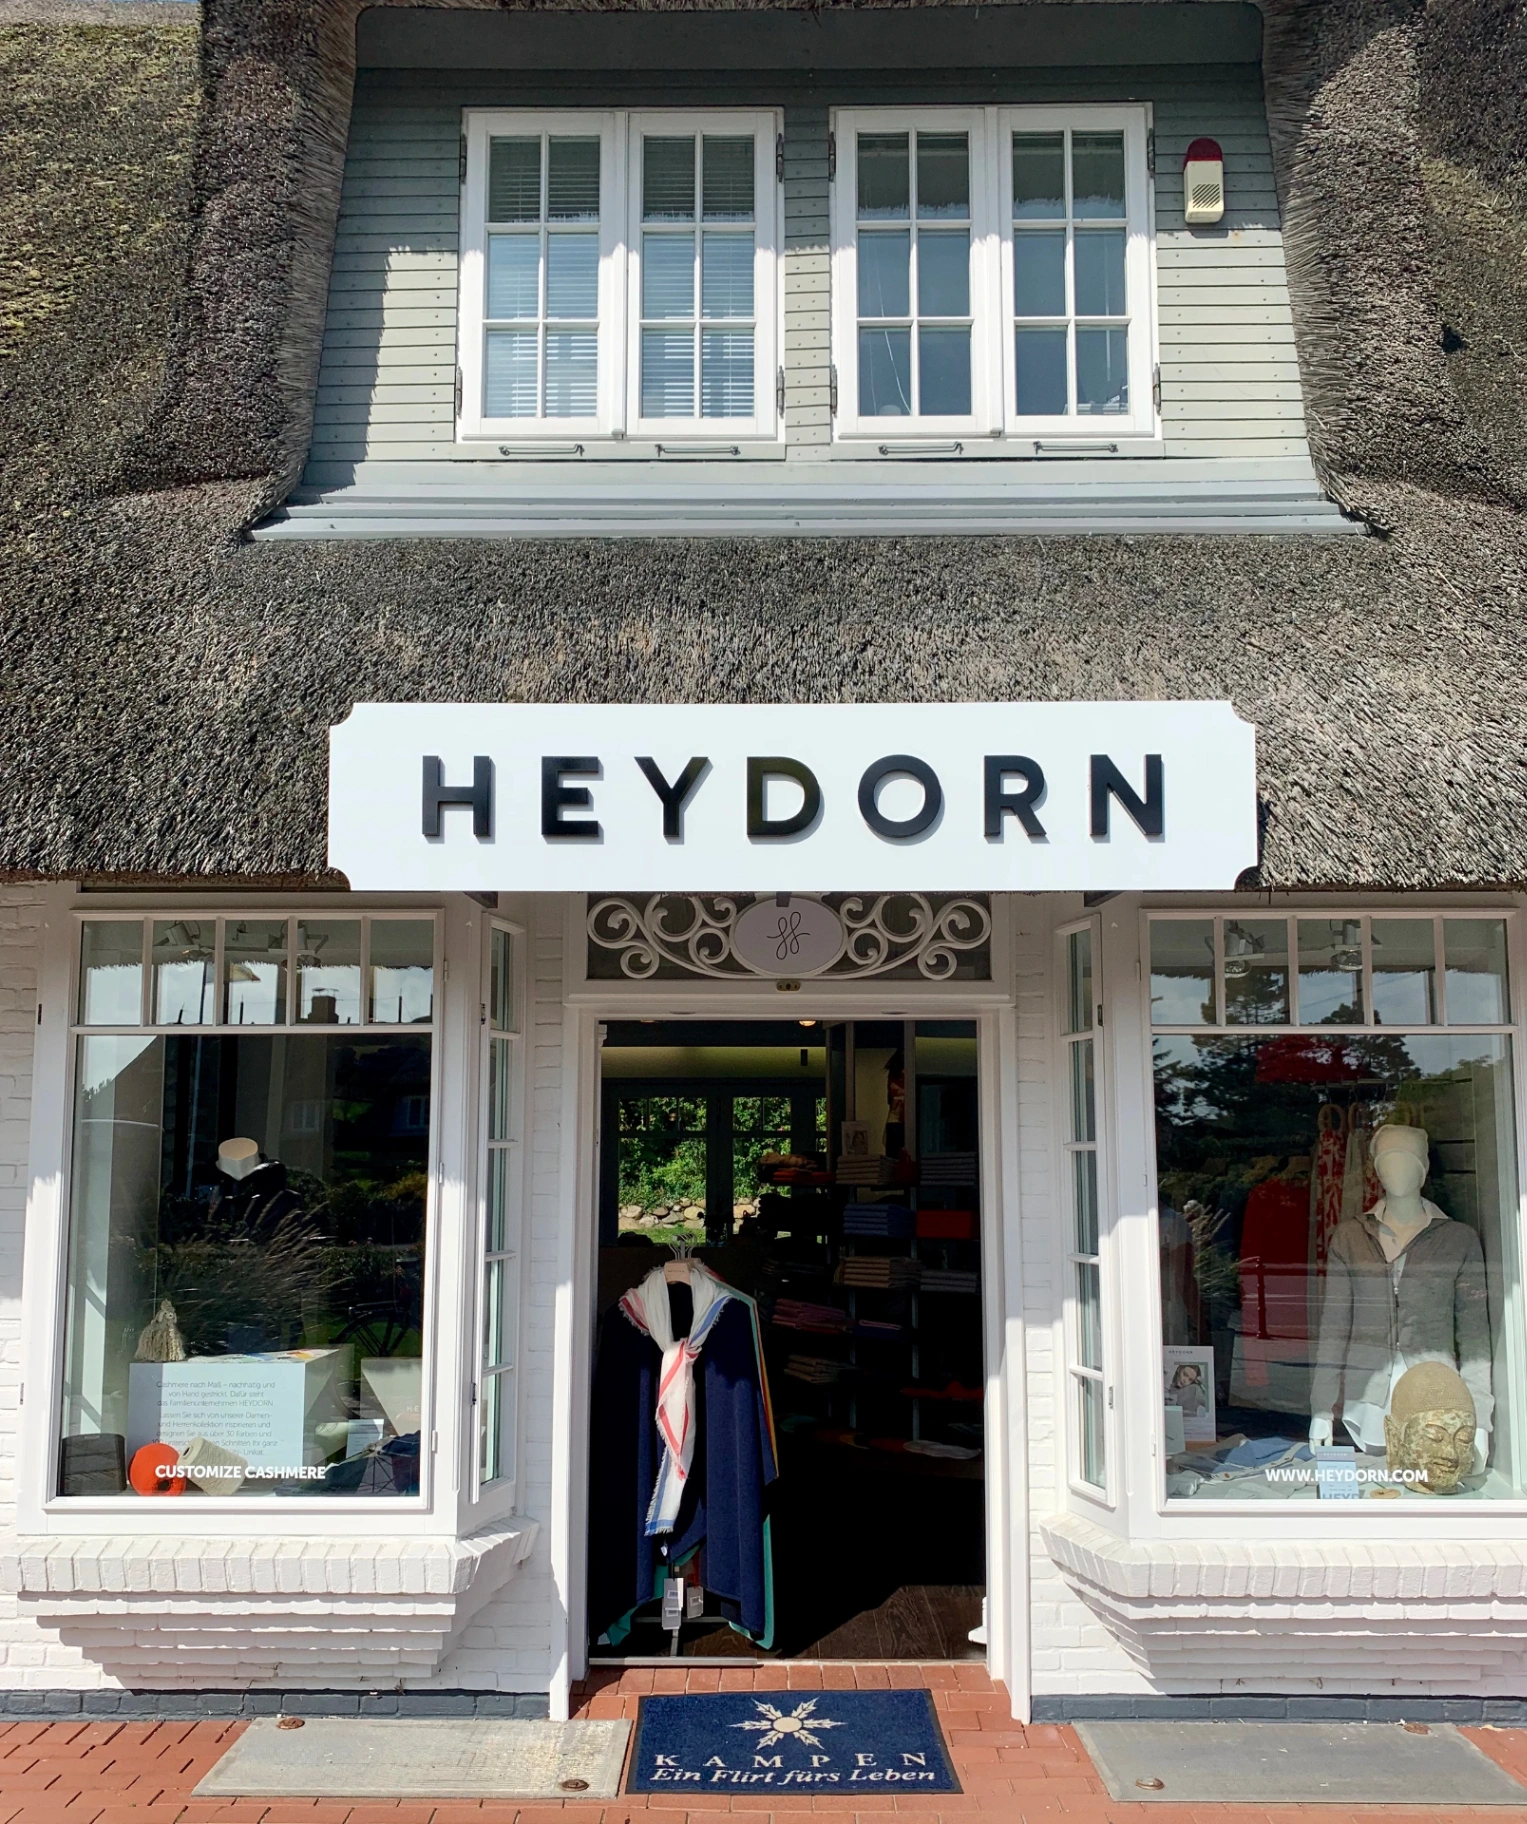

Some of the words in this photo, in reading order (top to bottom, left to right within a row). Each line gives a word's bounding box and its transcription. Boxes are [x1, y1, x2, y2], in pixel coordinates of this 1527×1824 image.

[422, 754, 1164, 838] HEYDORN
[156, 1380, 188, 1388] Cashmere
[190, 1380, 206, 1388] nach
[207, 1380, 222, 1388] Maß
[262, 1380, 276, 1388] und
[157, 1420, 171, 1428] und
[172, 1420, 223, 1428] Herrenkollektion
[225, 1420, 257, 1429] inspirieren
[258, 1420, 271, 1428] und
[156, 1430, 185, 1438] designen
[262, 1439, 278, 1448] ganz
[155, 1465, 241, 1480] CUSTOMIZE
[245, 1466, 326, 1480] CASHMERE
[1265, 1469, 1429, 1482] WWW.HEYDORN.COM
[654, 1753, 926, 1768] KAMPEN
[650, 1768, 701, 1781] Ein
[709, 1769, 776, 1782] Flirt
[777, 1769, 840, 1785] fürs
[848, 1769, 936, 1781] Leben
